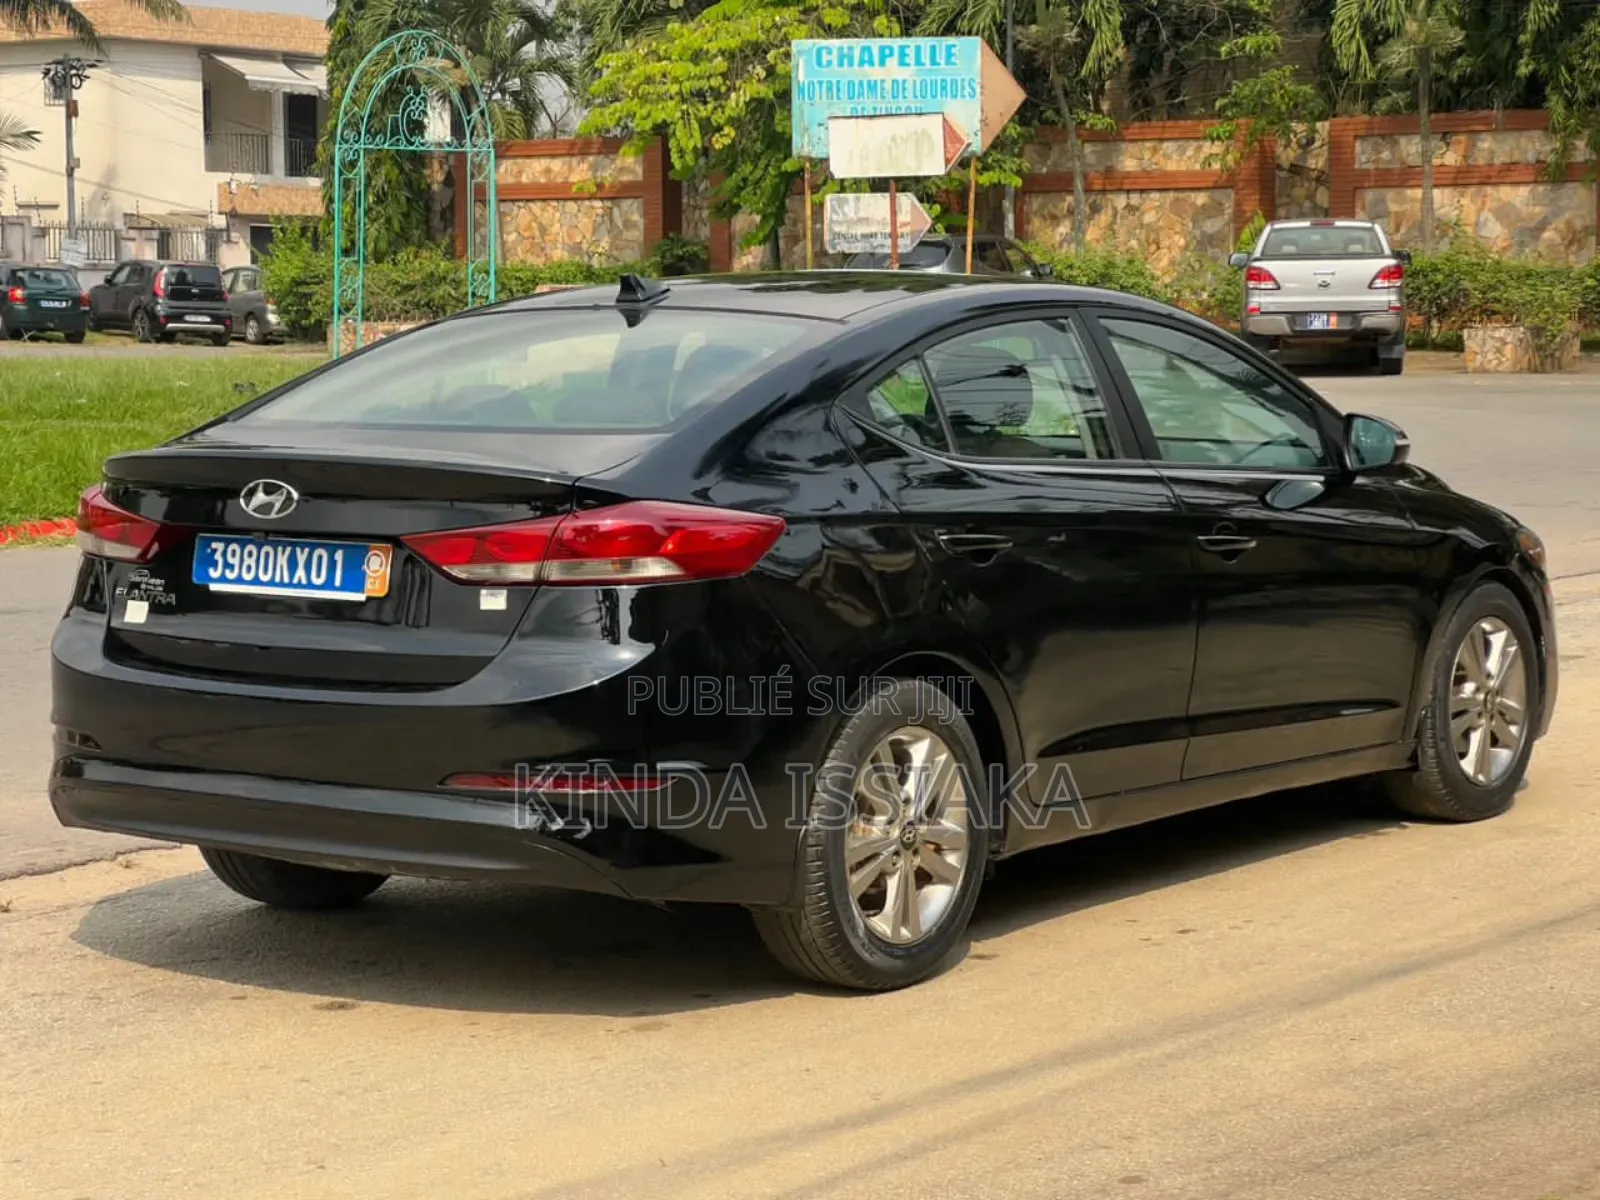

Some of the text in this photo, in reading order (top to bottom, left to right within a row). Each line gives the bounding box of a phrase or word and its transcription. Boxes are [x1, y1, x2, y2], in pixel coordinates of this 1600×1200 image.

[814, 43, 958, 69] CHAPELLE
[797, 77, 977, 101] NOTRE DAME DE LOURDES
[207, 541, 344, 588] 3980KX01
